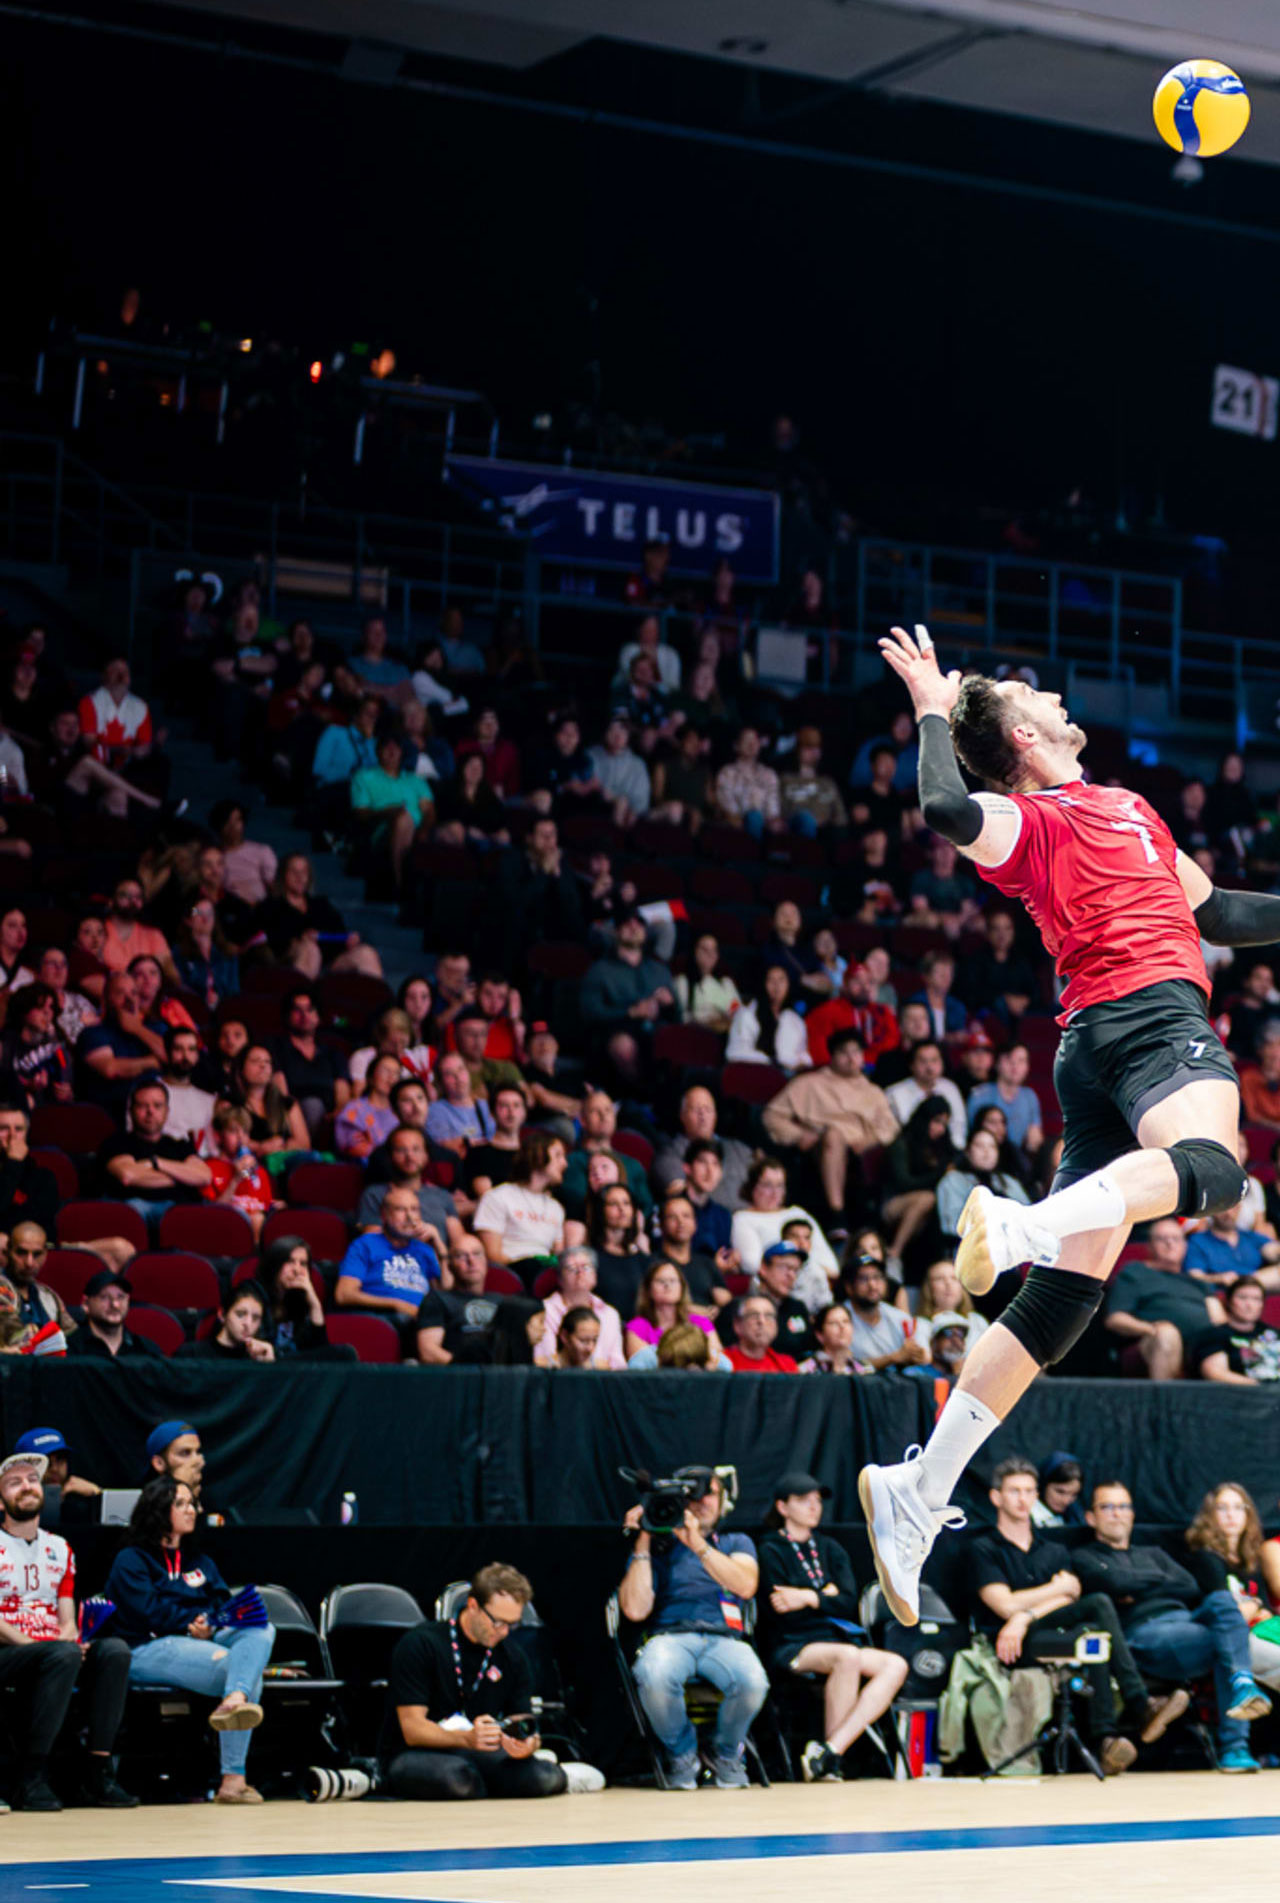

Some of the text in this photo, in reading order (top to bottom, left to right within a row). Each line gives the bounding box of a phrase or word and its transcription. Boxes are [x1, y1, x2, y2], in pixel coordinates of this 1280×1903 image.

[1219, 379, 1254, 419] 21
[576, 498, 744, 552] TELUS
[1188, 1039, 1206, 1058] 7
[24, 1564, 40, 1591] 13
